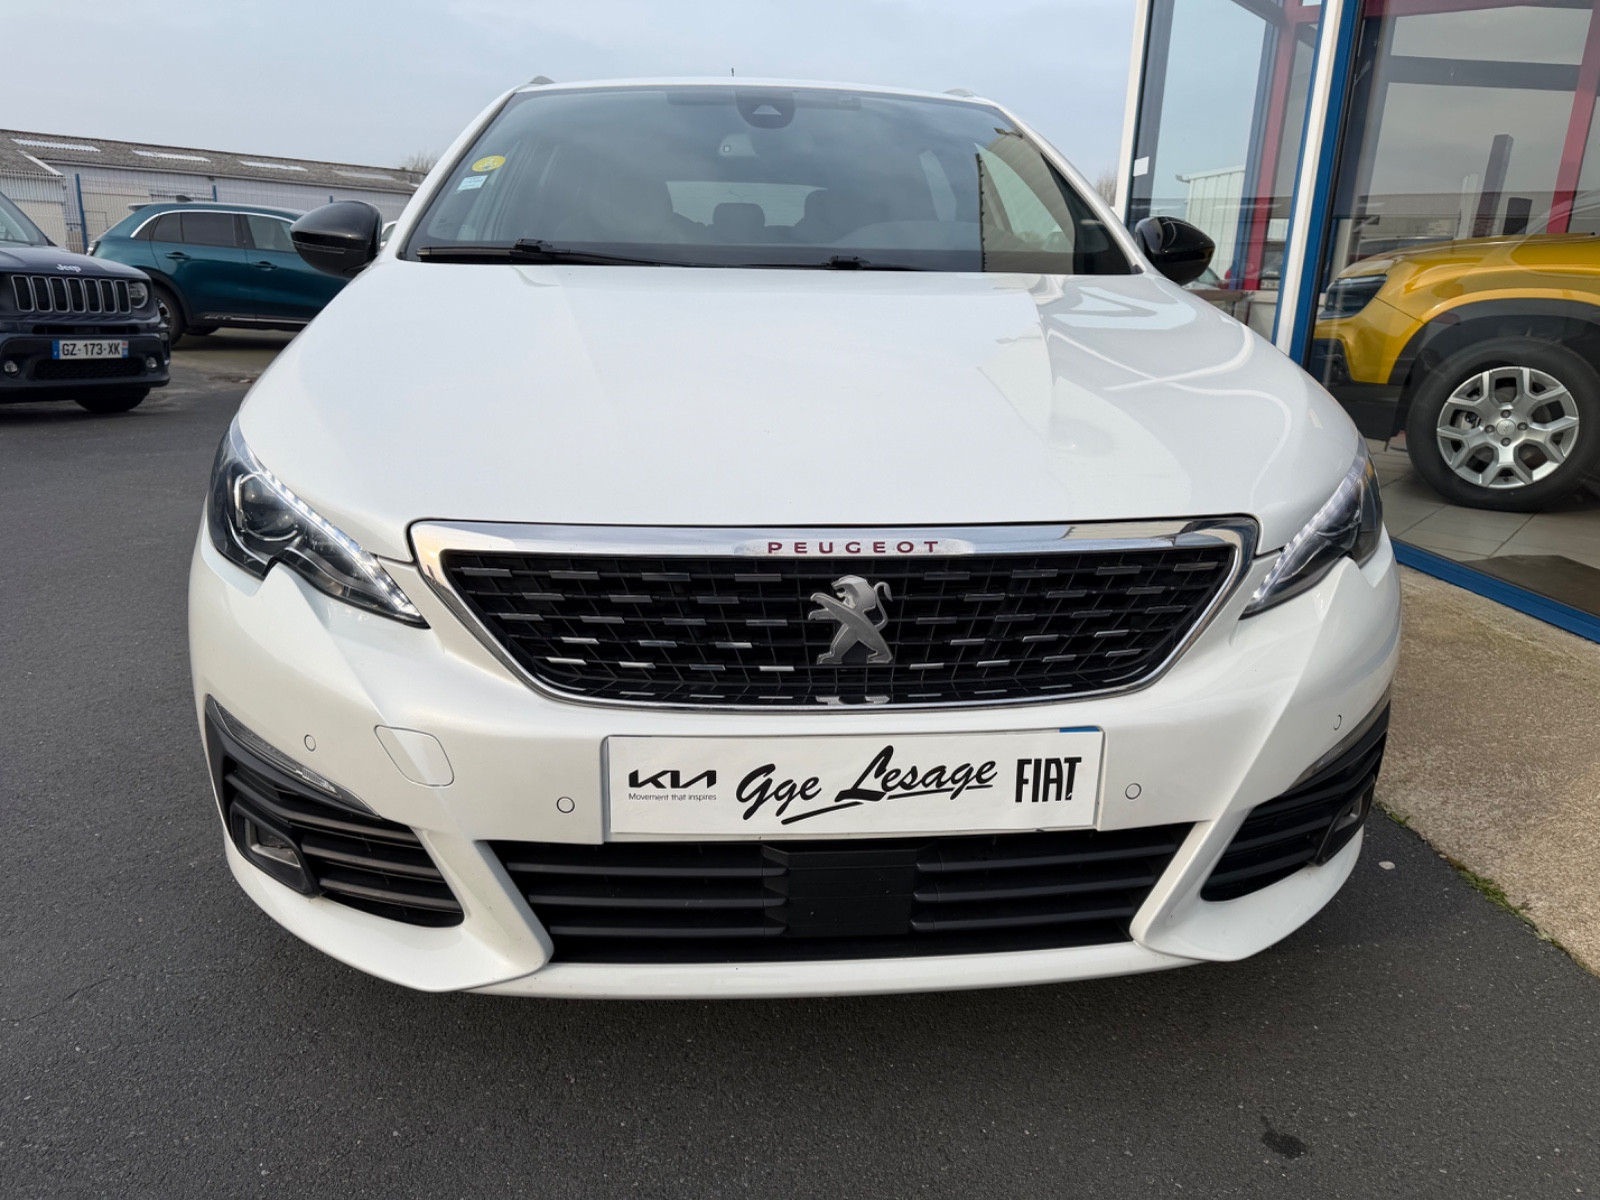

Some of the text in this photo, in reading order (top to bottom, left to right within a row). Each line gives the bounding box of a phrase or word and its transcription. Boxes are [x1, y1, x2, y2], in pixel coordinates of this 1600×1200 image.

[56, 264, 81, 273] Jeep
[62, 343, 121, 356] GZ-173-XK
[767, 541, 939, 554] PEUGEOT
[628, 769, 717, 789] KIA
[834, 745, 998, 801] Lesage
[1015, 757, 1082, 803] FIAT
[628, 793, 717, 802] Movement that inspires
